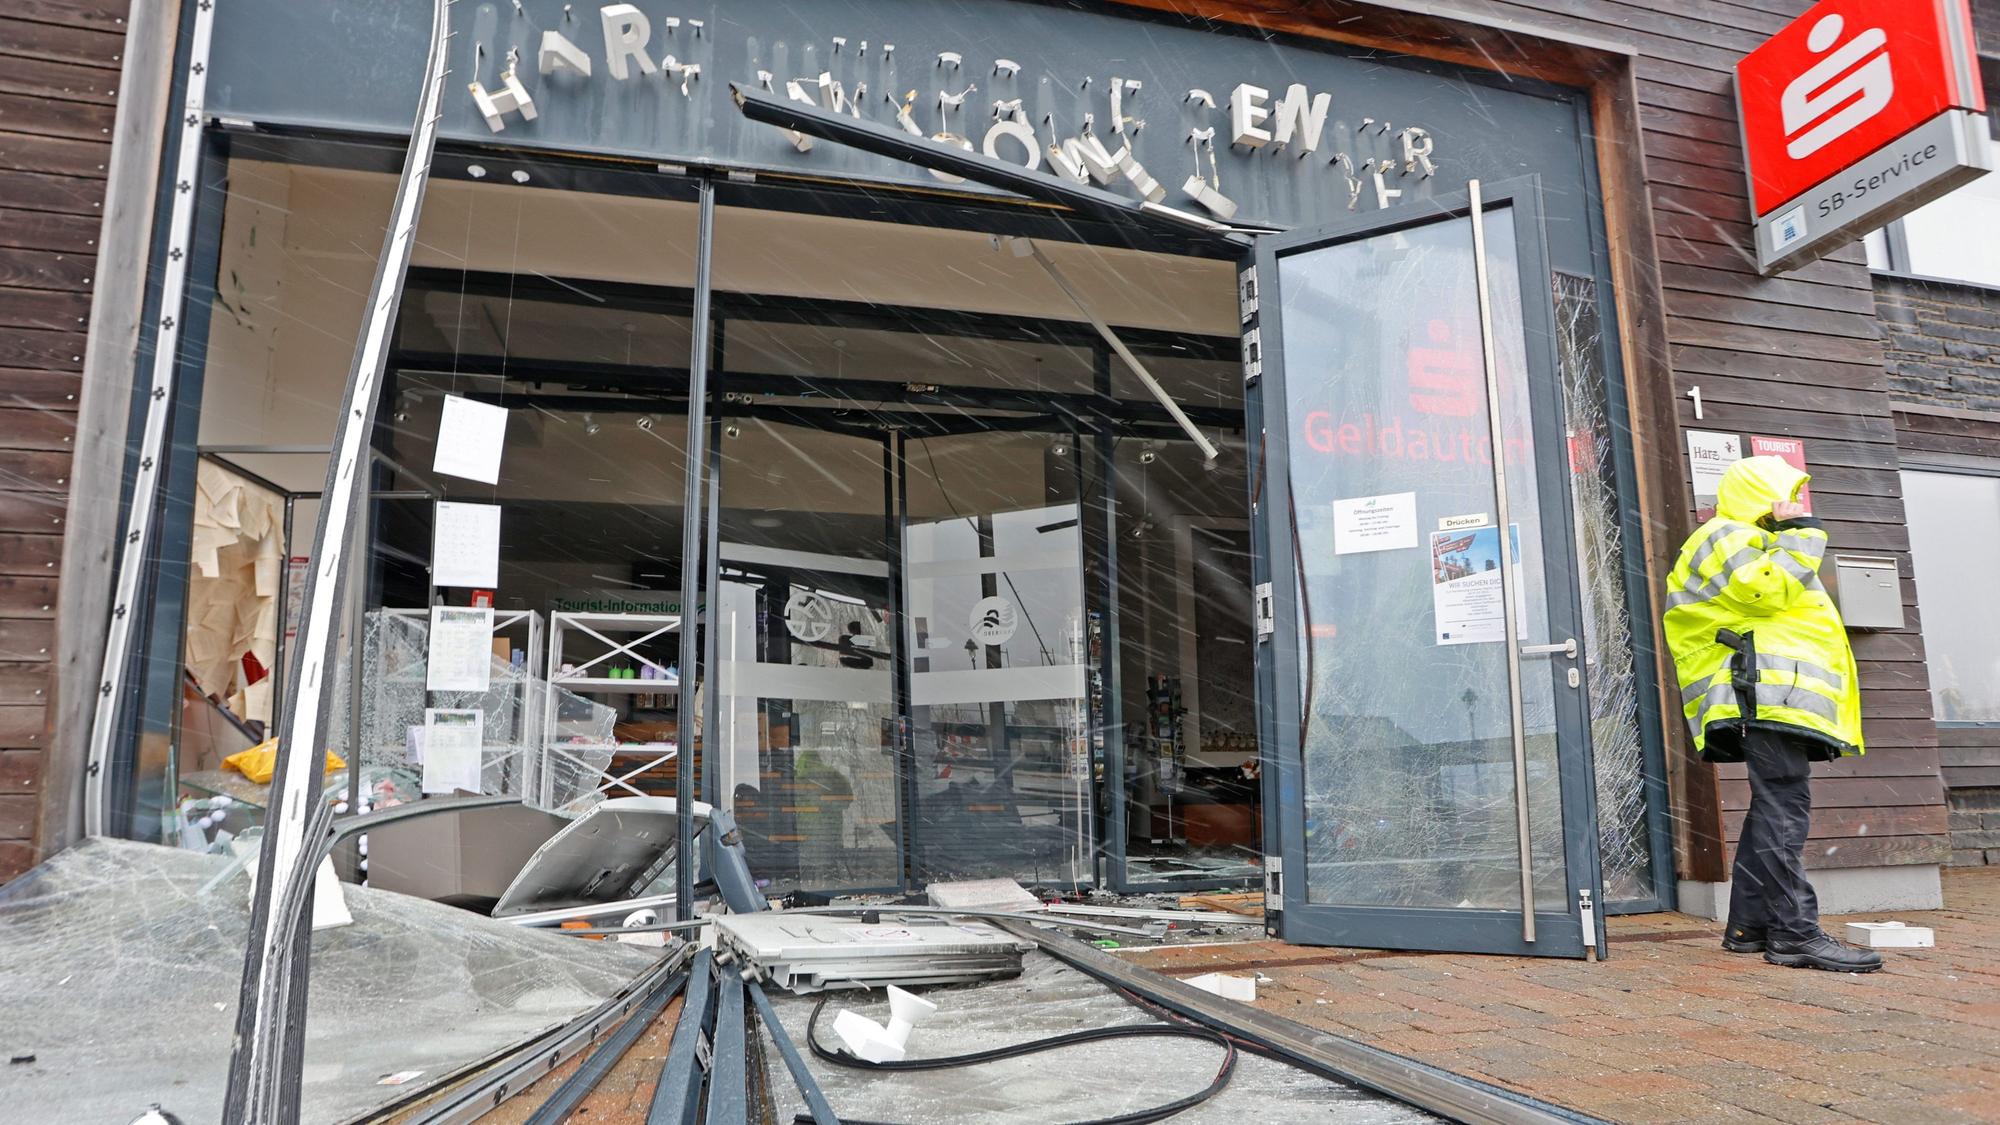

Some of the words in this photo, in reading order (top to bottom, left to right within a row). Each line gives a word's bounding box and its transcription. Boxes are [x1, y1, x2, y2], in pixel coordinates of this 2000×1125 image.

[1817, 143, 1938, 218] SB-Service
[1686, 385, 1704, 421] 1
[1693, 446, 1720, 461] Harz
[1757, 439, 1797, 454] TOURIST
[1446, 518, 1481, 527] Drücken
